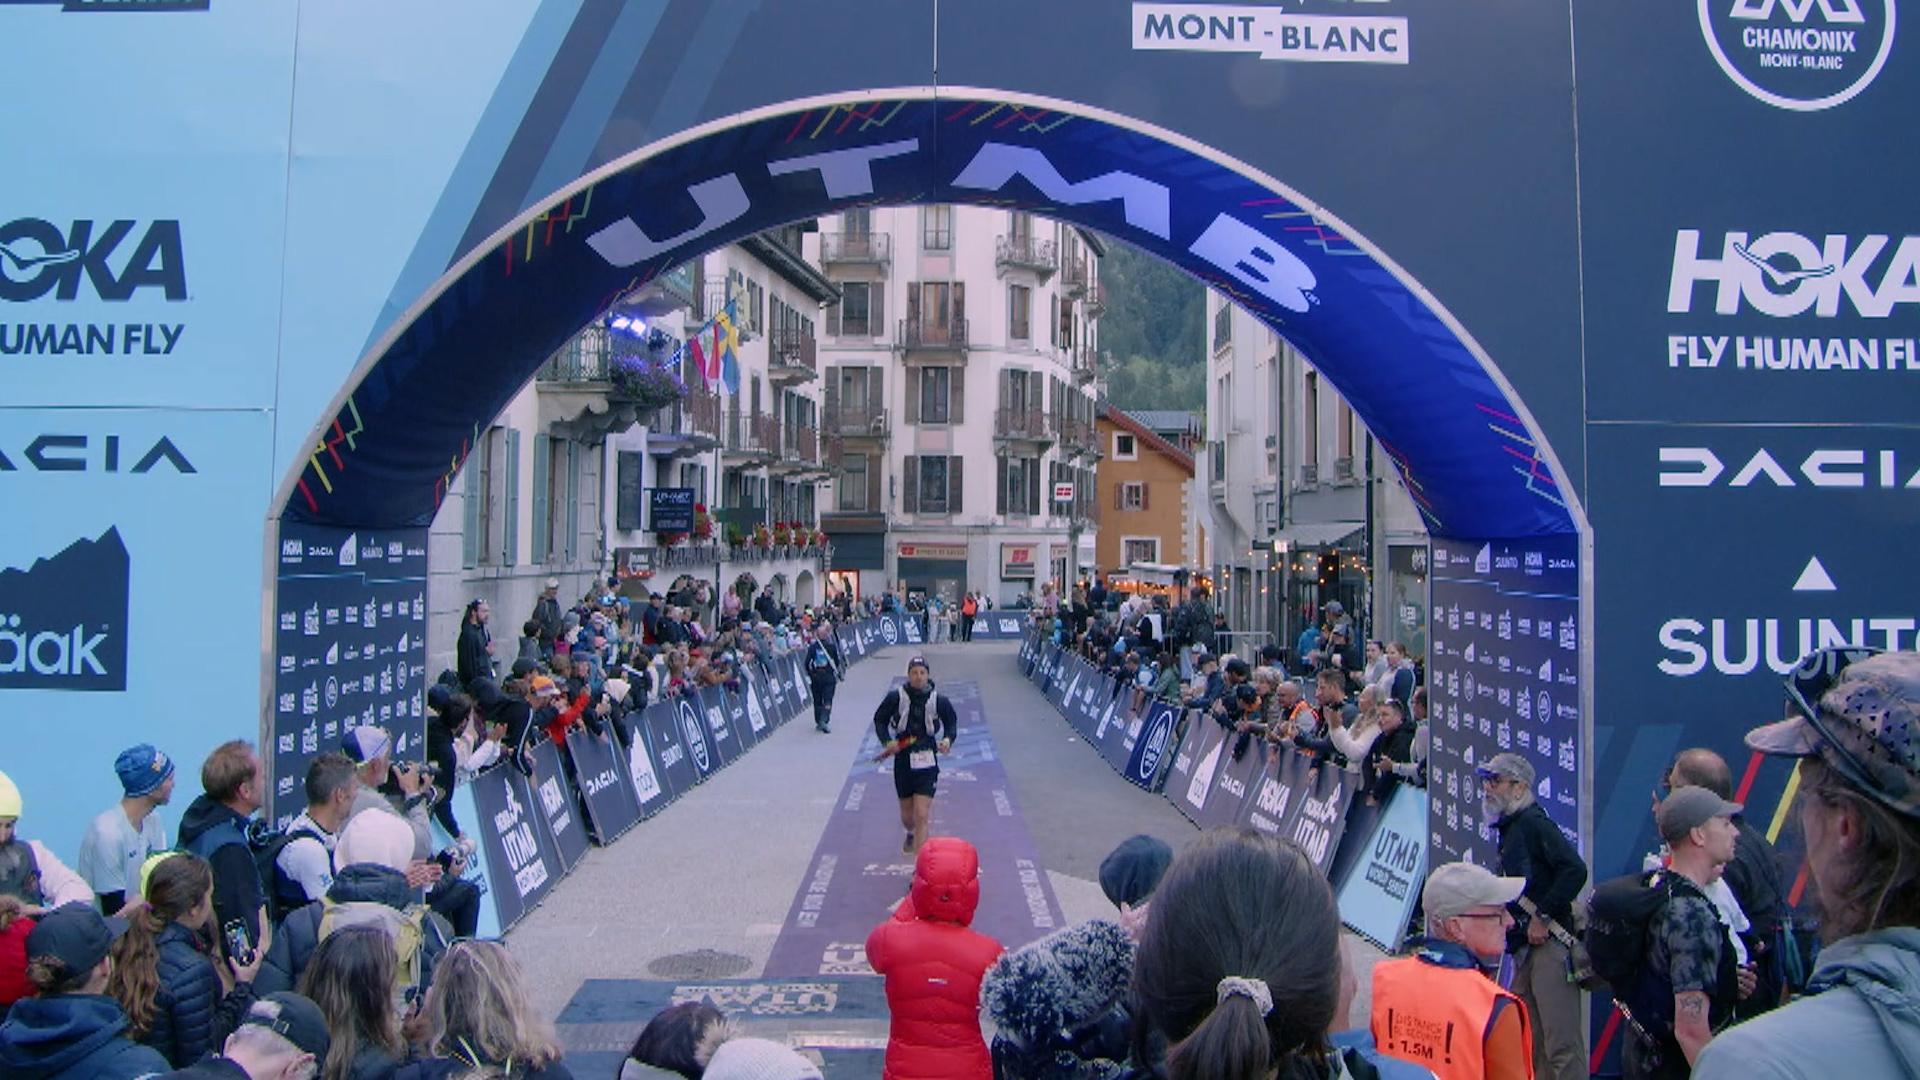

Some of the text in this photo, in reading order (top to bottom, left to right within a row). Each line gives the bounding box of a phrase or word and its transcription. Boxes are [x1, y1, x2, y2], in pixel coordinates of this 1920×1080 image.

[1742, 26, 1856, 52] CHAMONIX
[1759, 53, 1844, 70] MONT-BLANC
[585, 137, 1319, 314] UTMB
[0, 217, 188, 302] OKA
[1667, 229, 1920, 318] HOKA
[0, 323, 186, 355] UMAN FLY
[1668, 335, 1920, 370] FLY HUMAN FL
[0, 435, 198, 474] CIA
[1659, 447, 1920, 488] DACI
[309, 547, 334, 556] DACIA
[1548, 559, 1576, 569] DACIA
[0, 613, 109, 676] äak
[1657, 617, 1920, 676] SUUNT
[586, 768, 619, 797] DACIA
[1220, 773, 1246, 799] DACIA
[1256, 777, 1291, 819] HOKA
[501, 821, 538, 872] UTMB
[1375, 826, 1420, 874] UTMB
[1400, 1040, 1434, 1060] 1.5M
